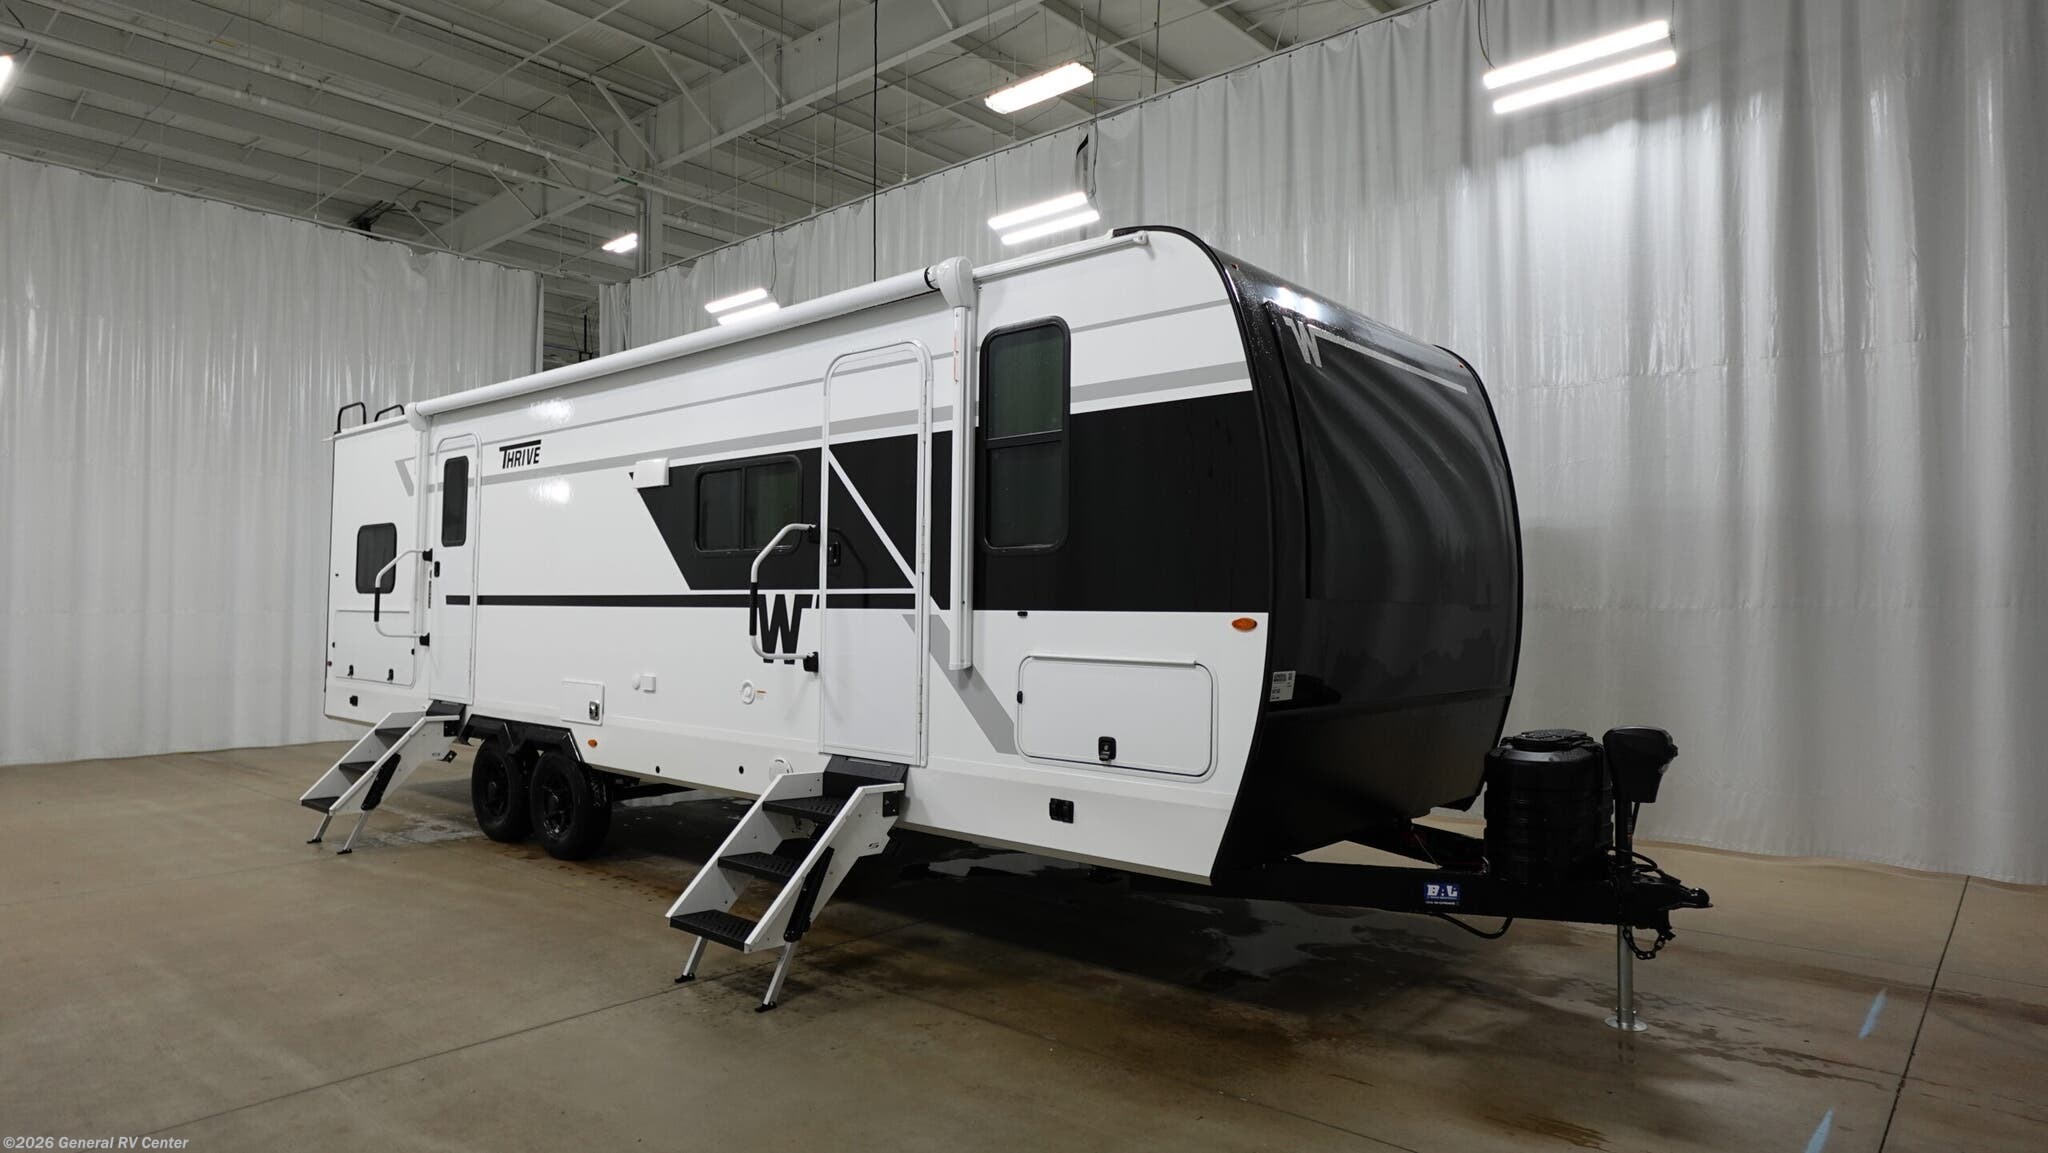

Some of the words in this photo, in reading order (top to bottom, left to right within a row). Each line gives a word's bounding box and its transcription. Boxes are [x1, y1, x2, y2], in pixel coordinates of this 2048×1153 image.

[1282, 315, 1322, 368] W
[499, 439, 542, 469] THRIVE
[757, 594, 814, 665] W
